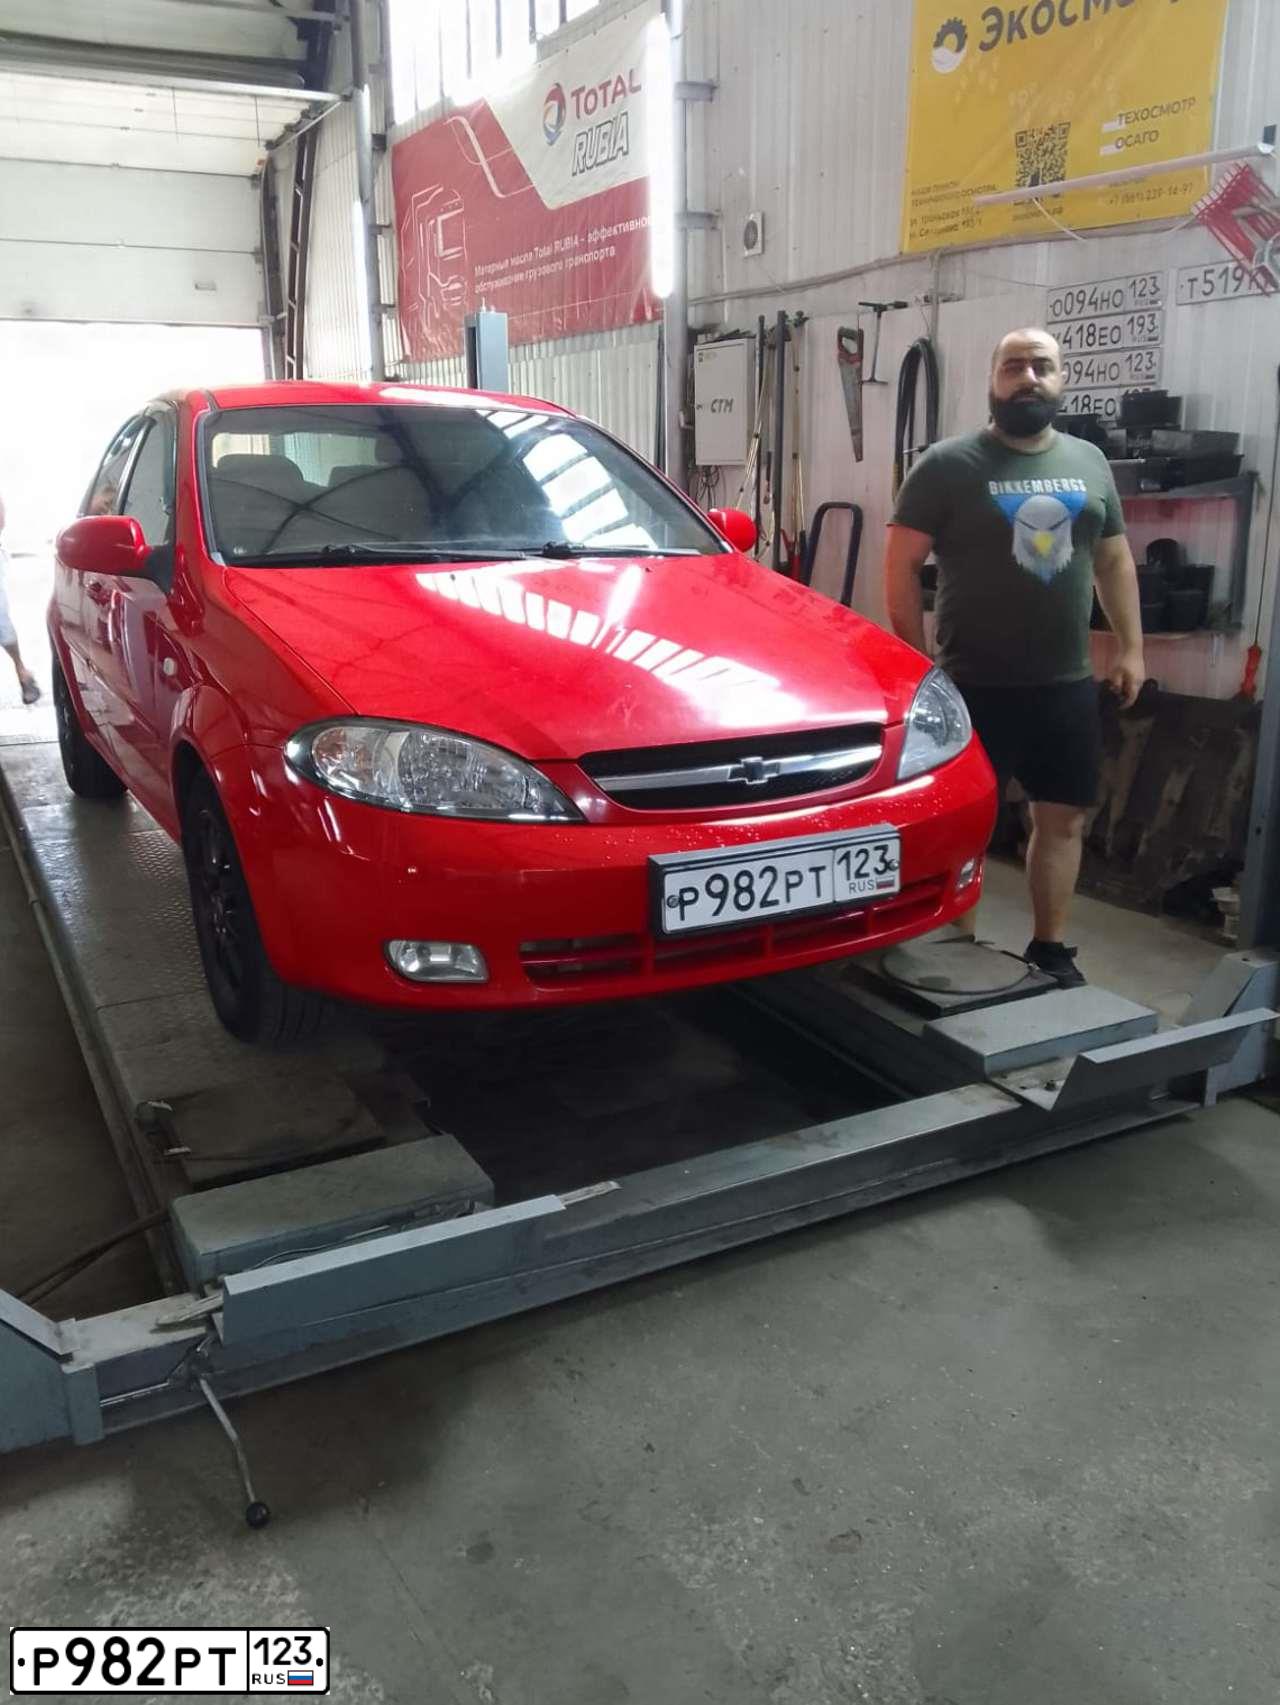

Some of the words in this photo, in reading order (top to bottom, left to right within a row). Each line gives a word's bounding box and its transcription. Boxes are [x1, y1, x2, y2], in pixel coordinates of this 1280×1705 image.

[979, 0, 1178, 51] ЭКОСМ
[571, 68, 642, 119] TOTAL
[1118, 96, 1196, 126] ТЕХОСМОТР
[572, 112, 630, 177] RUBIA
[1115, 130, 1159, 149] ОСАГО
[554, 234, 579, 252] RUBIA
[565, 246, 616, 270] транспорта
[1129, 276, 1158, 298] 123
[1127, 313, 1156, 335] 193
[1125, 351, 1155, 373] 123
[678, 865, 826, 921] Р982РТ
[837, 844, 889, 881] 123
[850, 879, 875, 894] RUS
